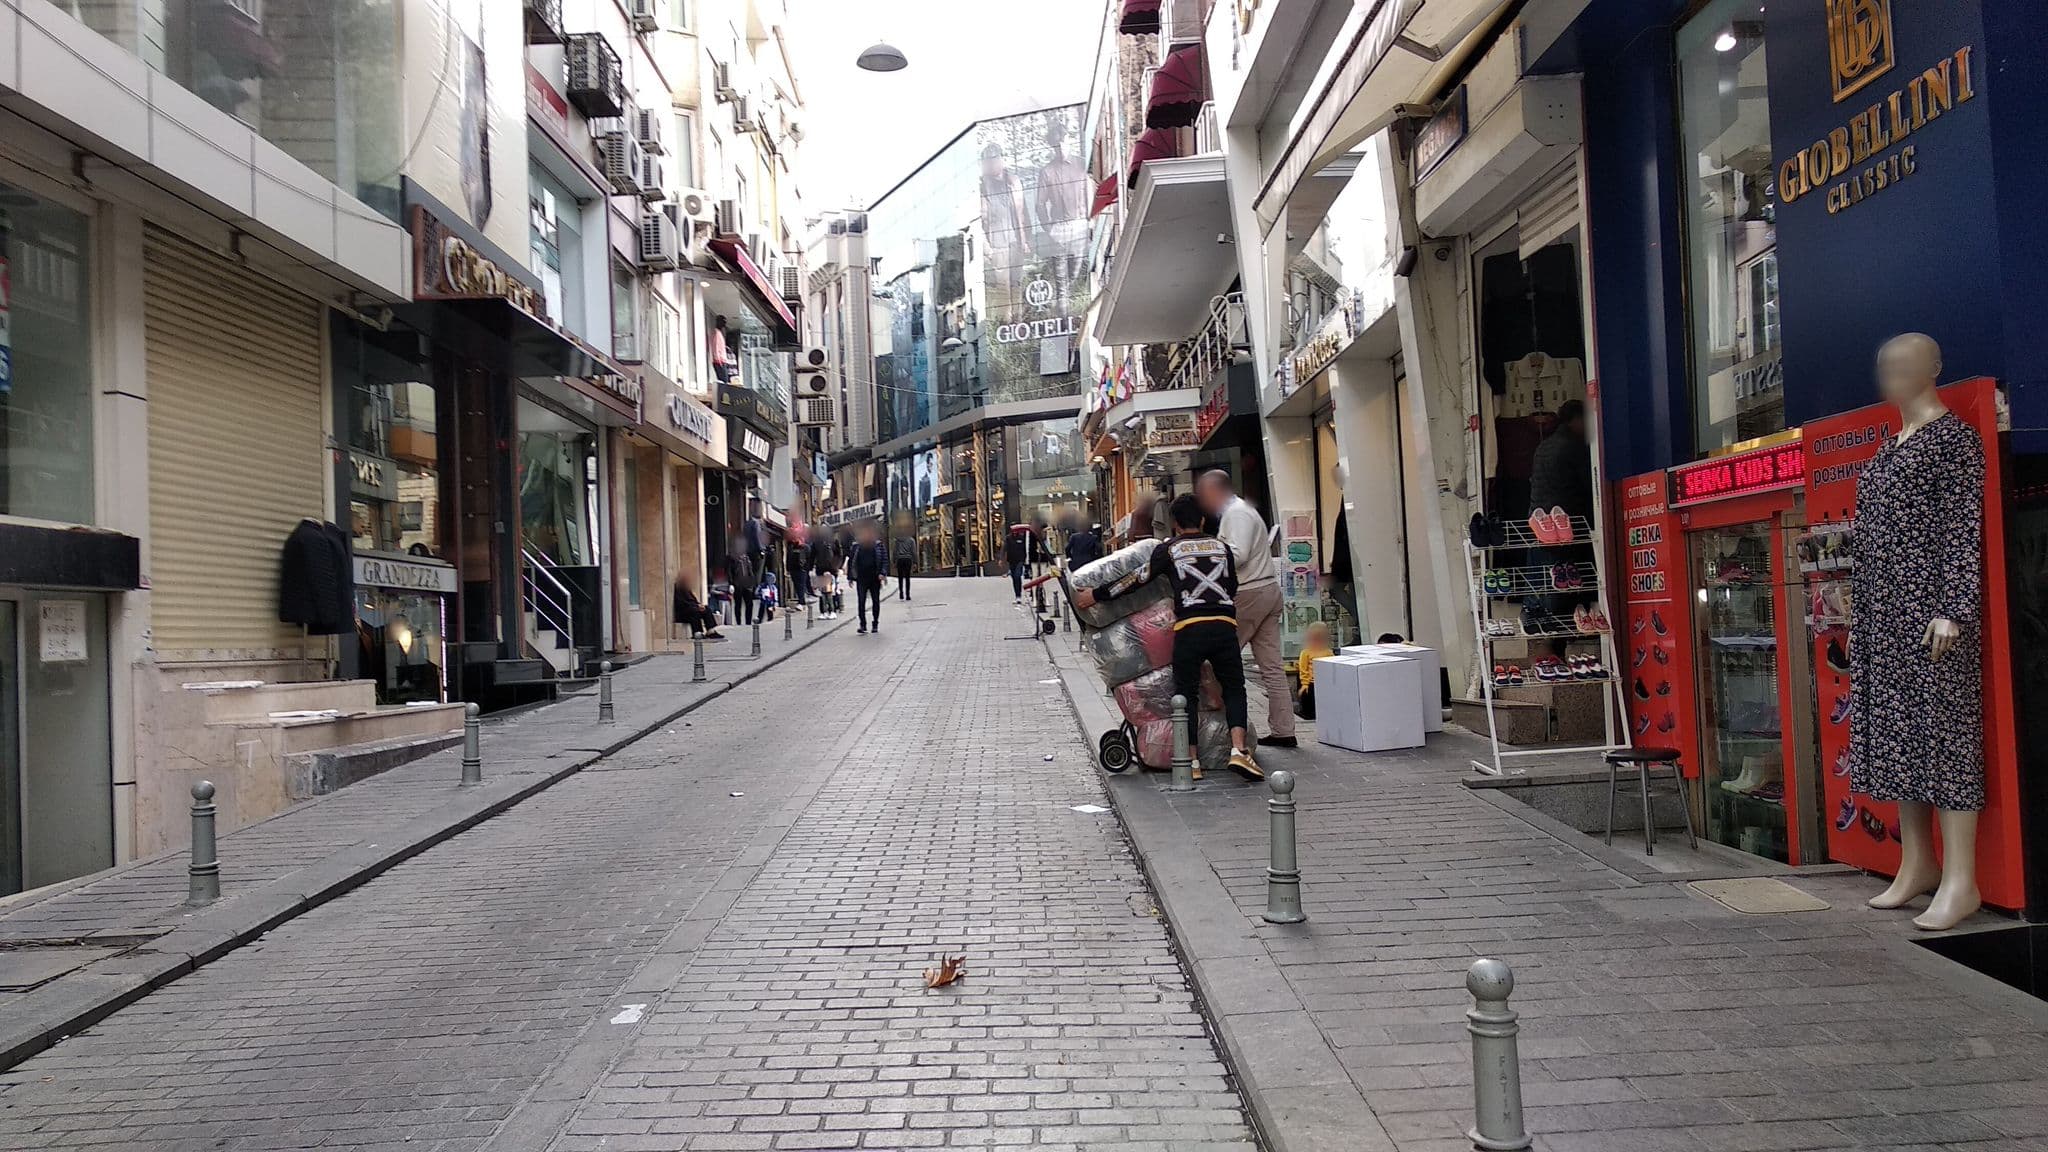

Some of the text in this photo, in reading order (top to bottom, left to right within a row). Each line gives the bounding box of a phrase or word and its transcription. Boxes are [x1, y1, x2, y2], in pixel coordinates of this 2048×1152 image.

[1779, 46, 1974, 203] GIOBELLINI
[1827, 145, 1916, 214] CLASSIC
[996, 315, 1082, 343] GIOTELL
[1813, 425, 1876, 456] оптовые
[1685, 450, 1805, 496] SERKA KIDS SH
[1629, 523, 1662, 546] SERKA
[1632, 547, 1657, 569] KIDS
[1631, 571, 1666, 593] SHOES
